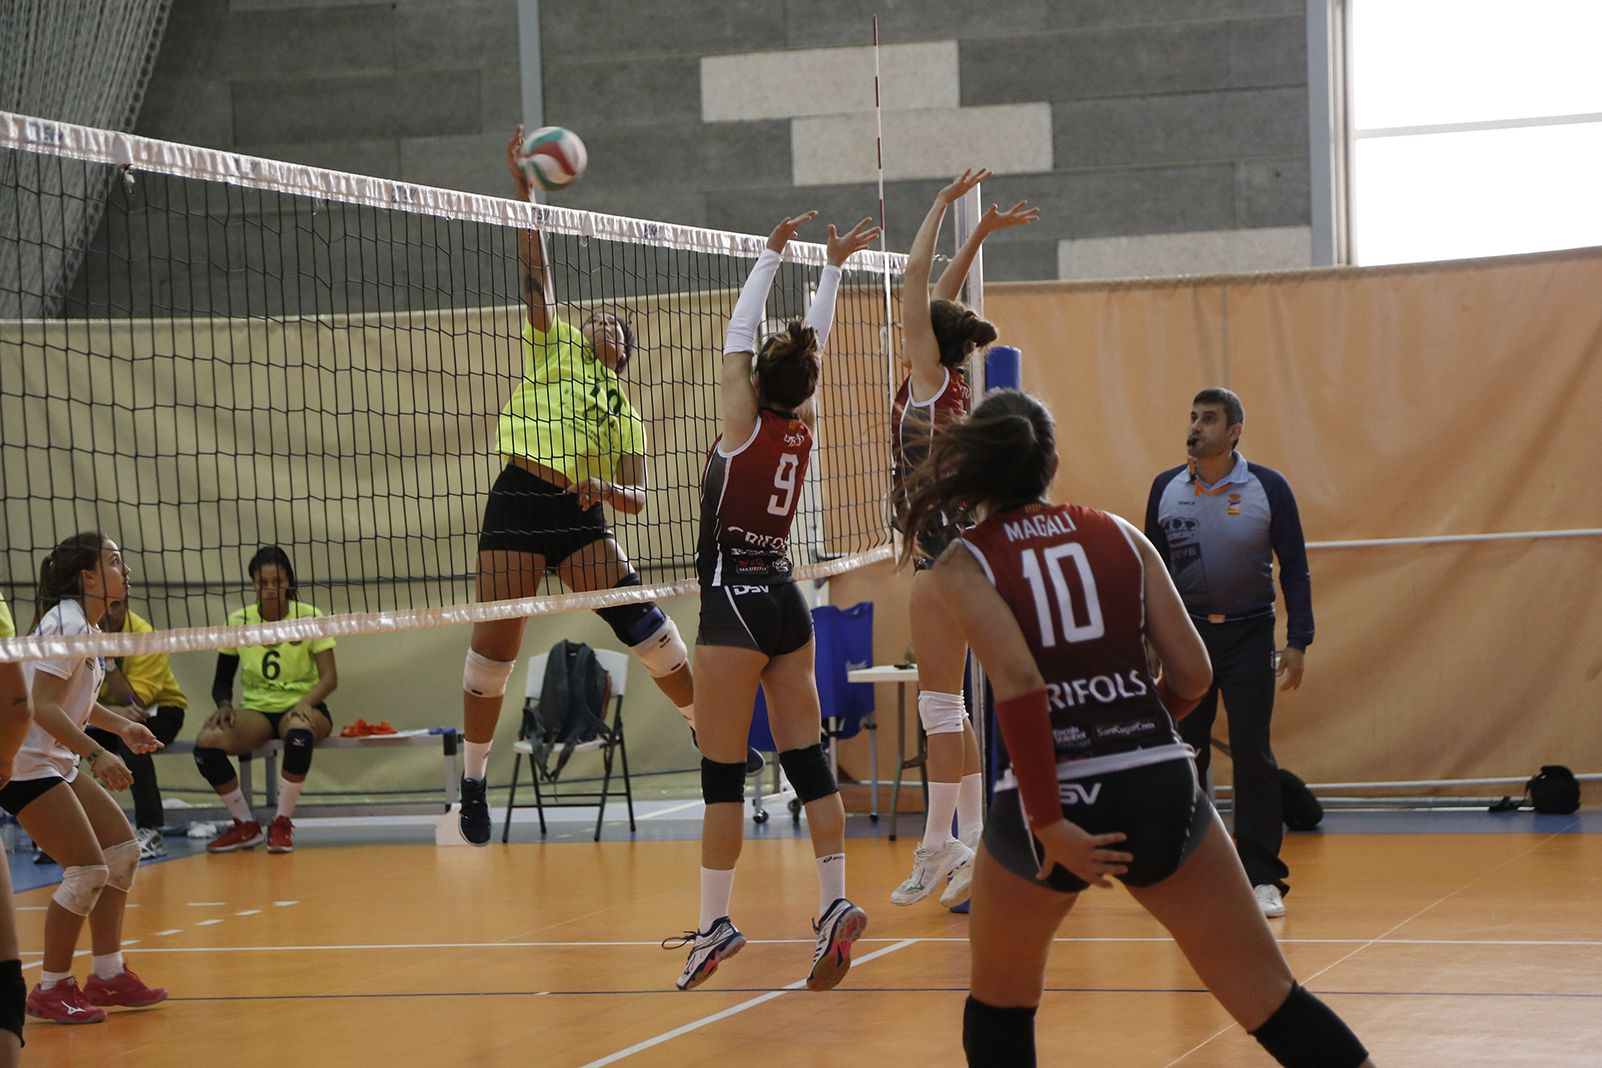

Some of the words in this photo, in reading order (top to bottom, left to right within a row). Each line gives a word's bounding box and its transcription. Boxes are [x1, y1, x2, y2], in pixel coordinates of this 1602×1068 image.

[767, 453, 799, 516] 9
[1003, 511, 1077, 543] MAGALI
[732, 584, 769, 596] DSV
[1020, 542, 1105, 648] 10
[261, 649, 281, 680] 6
[1045, 669, 1147, 712] RIFOLS
[1058, 782, 1102, 805] SV
